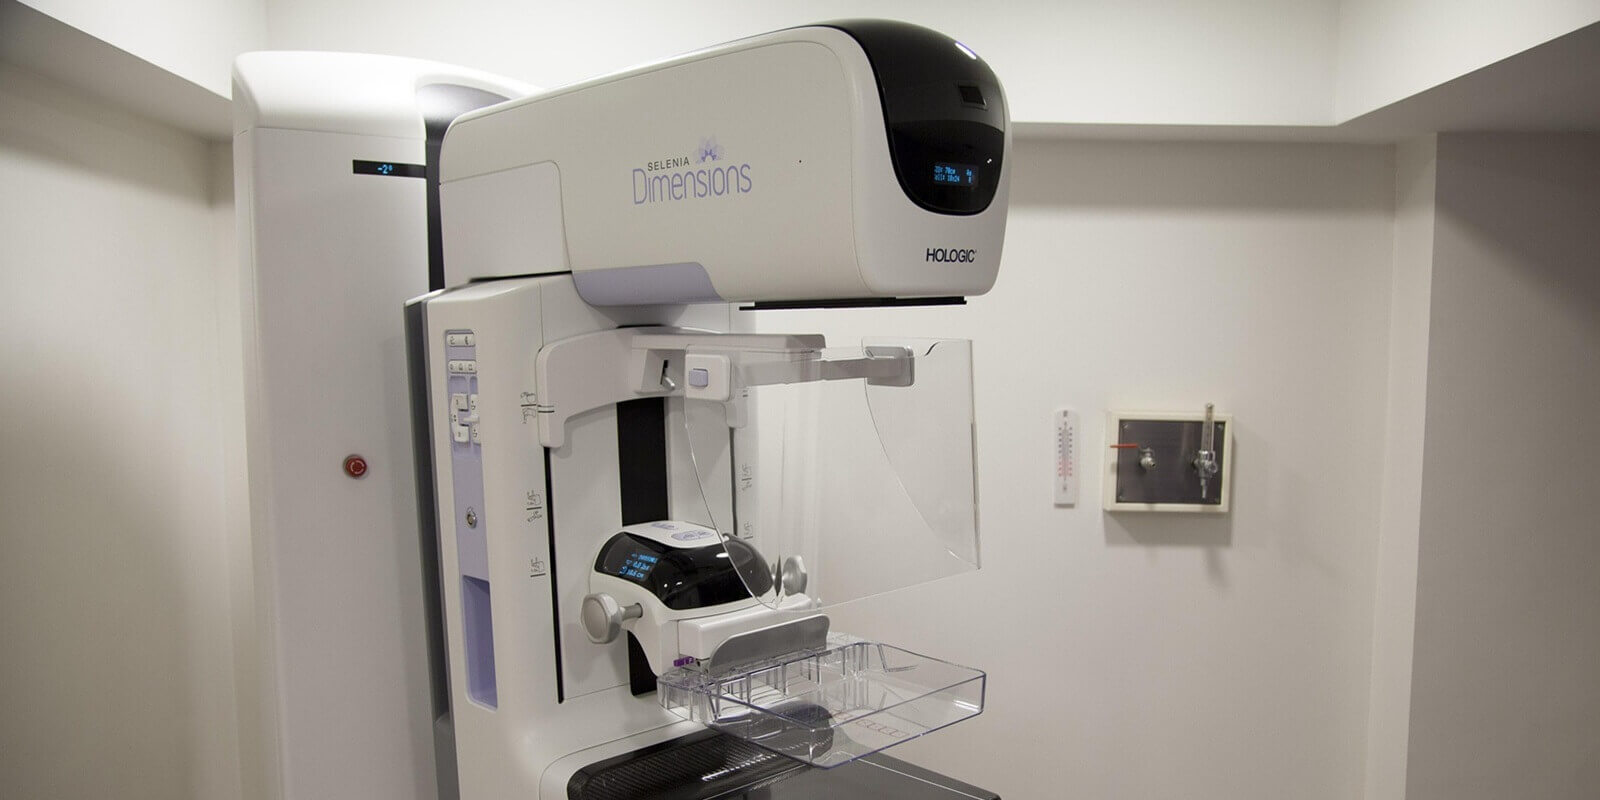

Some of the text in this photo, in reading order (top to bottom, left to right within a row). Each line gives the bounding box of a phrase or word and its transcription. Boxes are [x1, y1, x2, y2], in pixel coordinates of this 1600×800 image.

[647, 156, 690, 171] SELENIA
[632, 163, 752, 204] Dimensions
[926, 247, 976, 263] HOLOGIC
